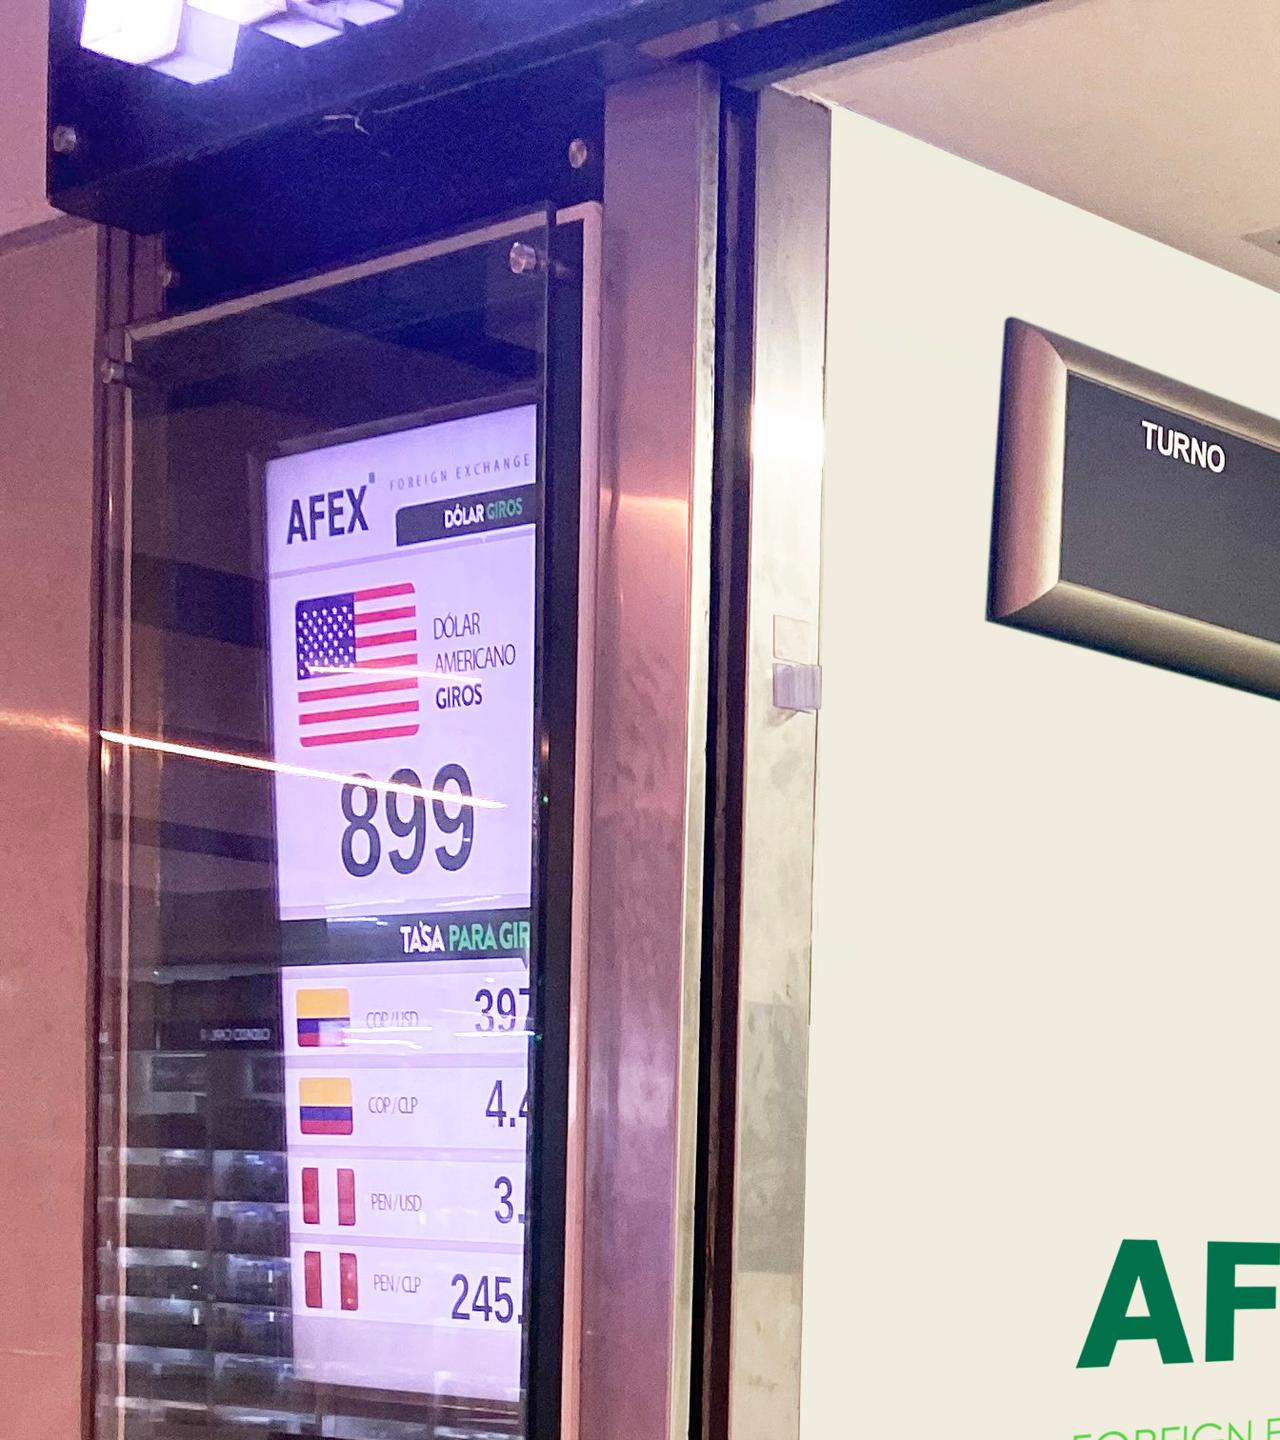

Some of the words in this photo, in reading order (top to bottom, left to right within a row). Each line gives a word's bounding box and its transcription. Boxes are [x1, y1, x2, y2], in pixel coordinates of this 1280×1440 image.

[1141, 419, 1226, 474] TURNO
[389, 469, 448, 491] FOREIGN
[456, 453, 531, 479] EXCHANGE
[286, 484, 370, 544] AFEX
[444, 501, 485, 528] DÓLAR
[486, 497, 524, 521] GIROS
[433, 611, 481, 640] DÓLAR
[435, 643, 516, 674] AMERICANO
[435, 683, 483, 710] GIROS
[340, 762, 475, 878] 899
[399, 923, 446, 954] TASA
[448, 922, 498, 952] PARA
